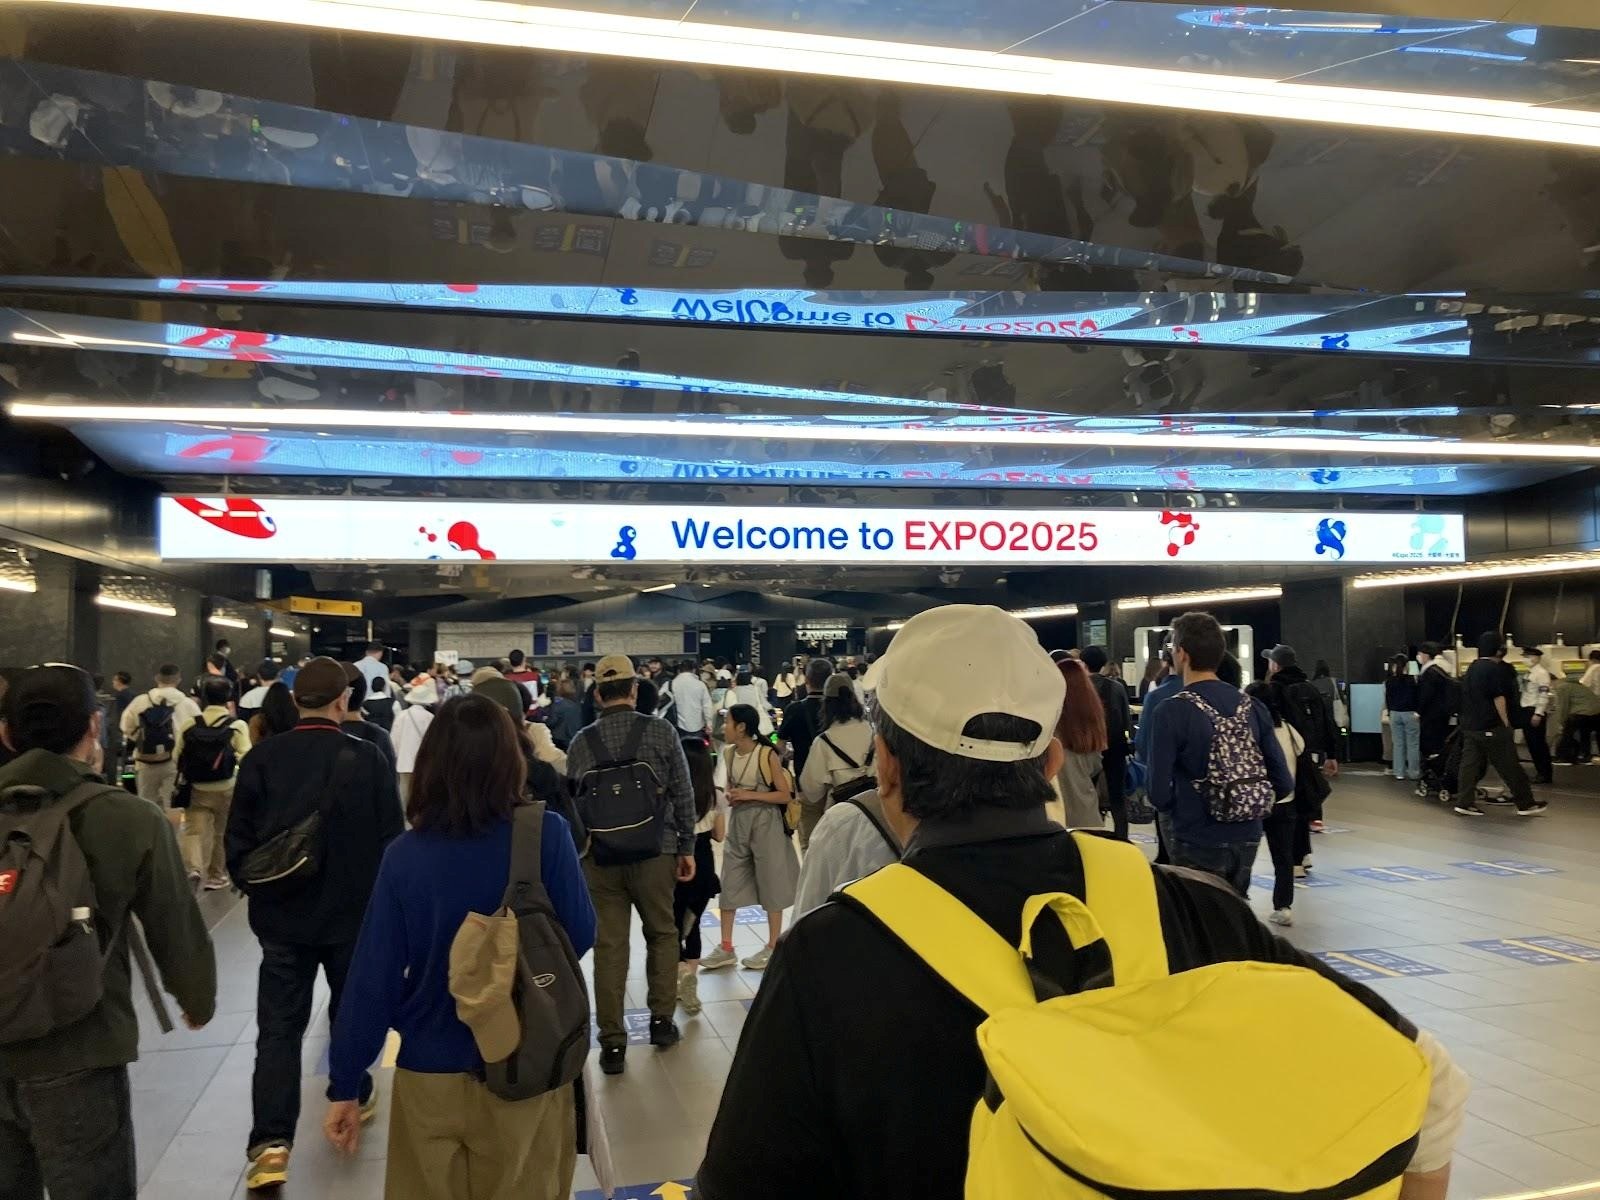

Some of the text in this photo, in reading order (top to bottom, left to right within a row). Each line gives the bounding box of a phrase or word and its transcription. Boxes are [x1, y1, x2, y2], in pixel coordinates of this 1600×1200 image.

[671, 518, 1098, 551] Welcome to EXPO2025
